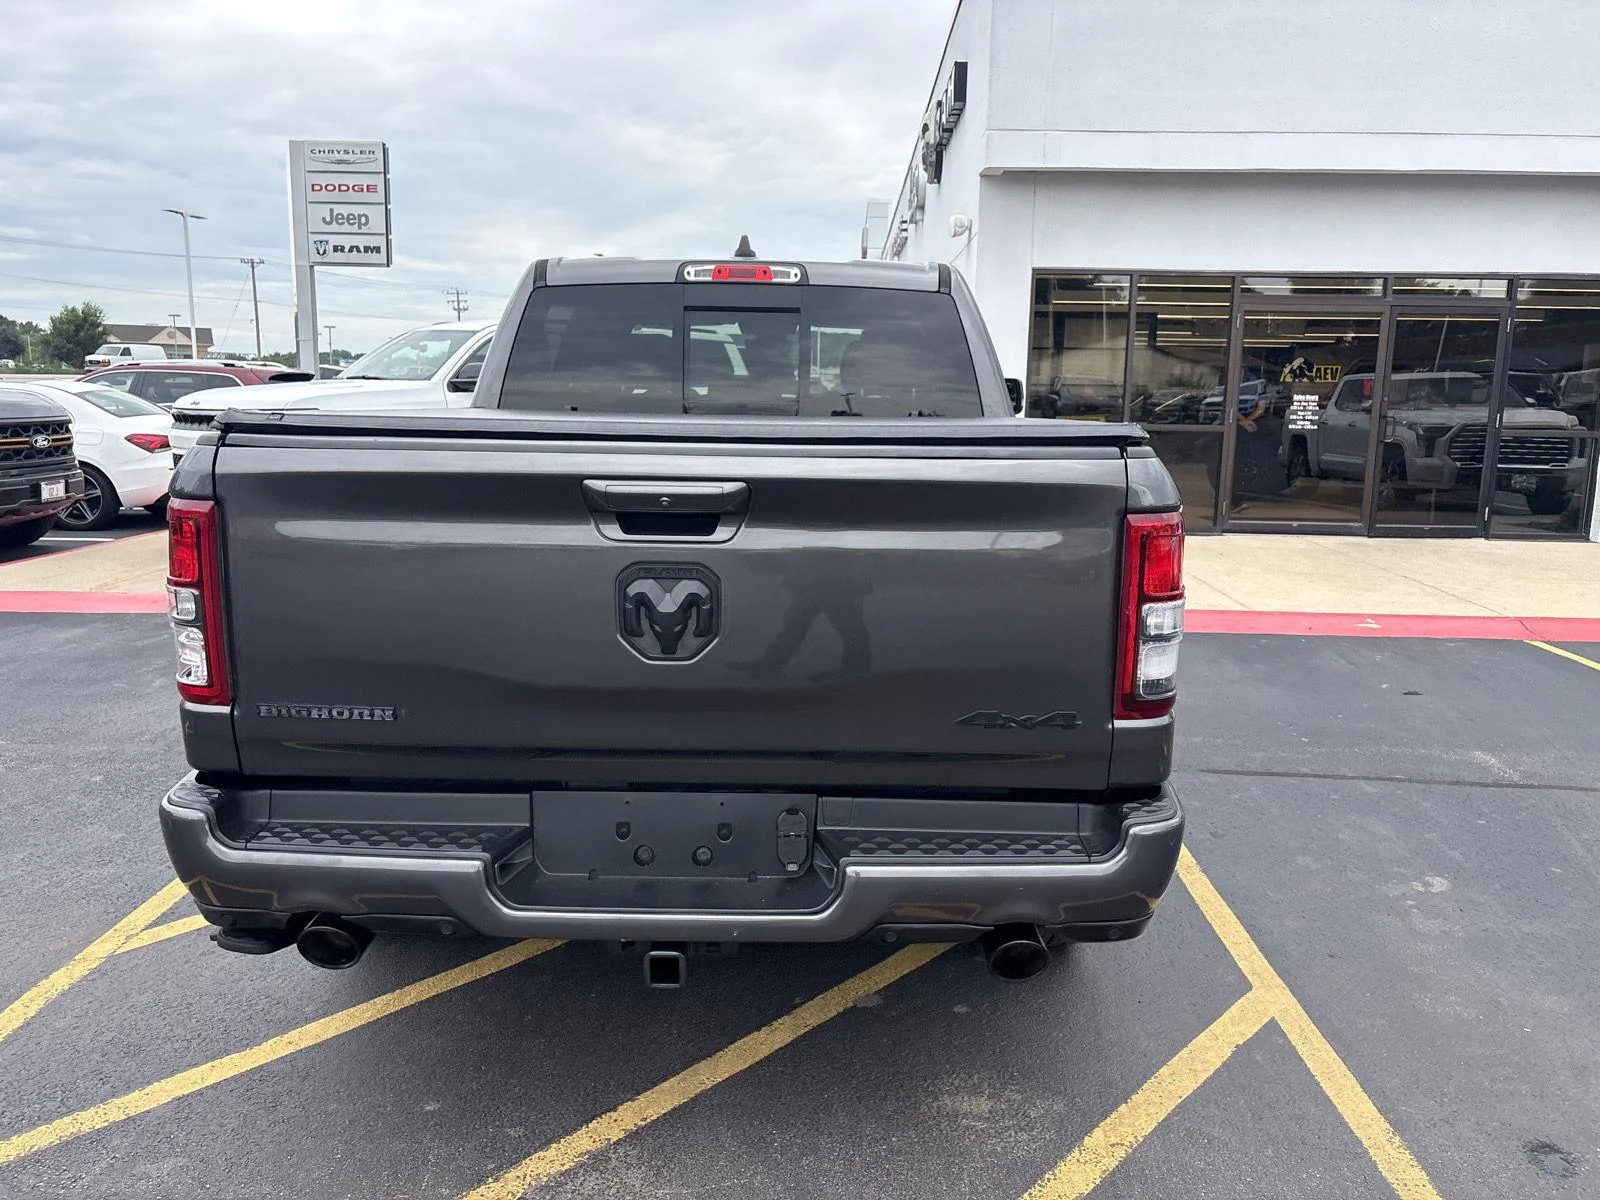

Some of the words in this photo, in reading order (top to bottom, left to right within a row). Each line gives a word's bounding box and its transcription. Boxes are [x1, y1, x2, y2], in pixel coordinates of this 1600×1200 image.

[310, 148, 376, 156] CHRYSLER
[311, 183, 379, 193] DODGE
[322, 208, 370, 230] Jeep
[332, 244, 382, 255] RAM
[1314, 366, 1340, 382] AEV
